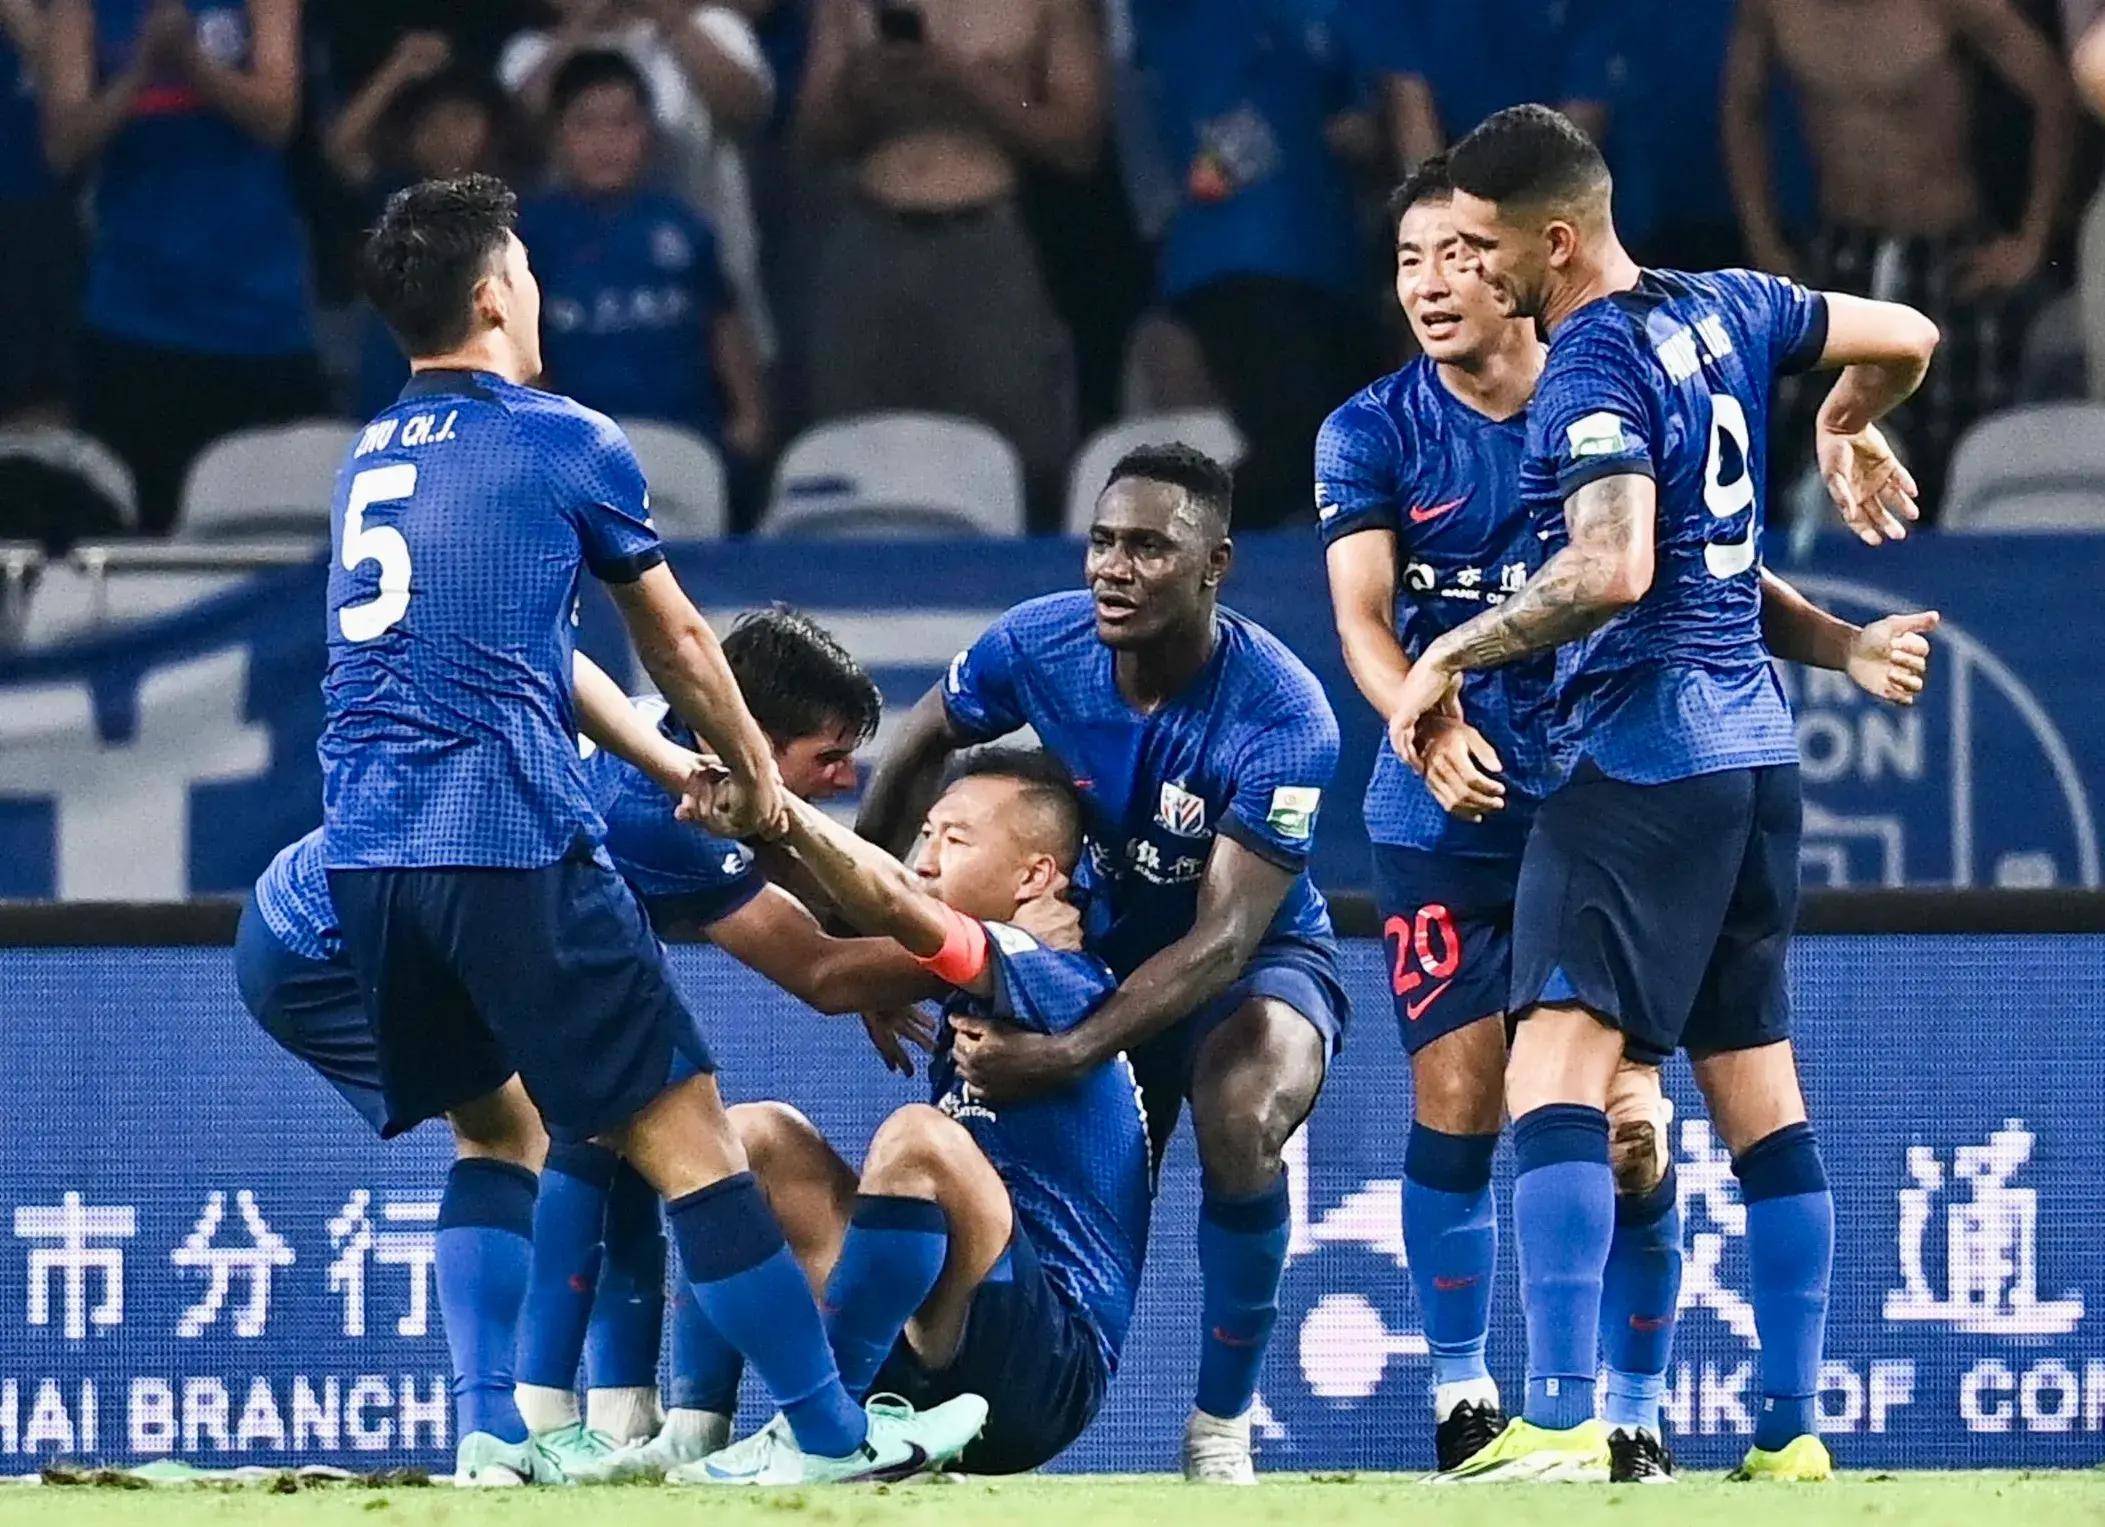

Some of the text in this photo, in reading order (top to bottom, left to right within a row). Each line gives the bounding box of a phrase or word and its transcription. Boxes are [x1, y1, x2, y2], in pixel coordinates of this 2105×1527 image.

[1703, 392, 1756, 580] 9
[338, 463, 418, 642] 5
[1384, 903, 1459, 996] 20
[14, 1190, 441, 1338] 市分行
[127, 1374, 447, 1454] BRANCH
[1814, 1358, 1916, 1433] OF
